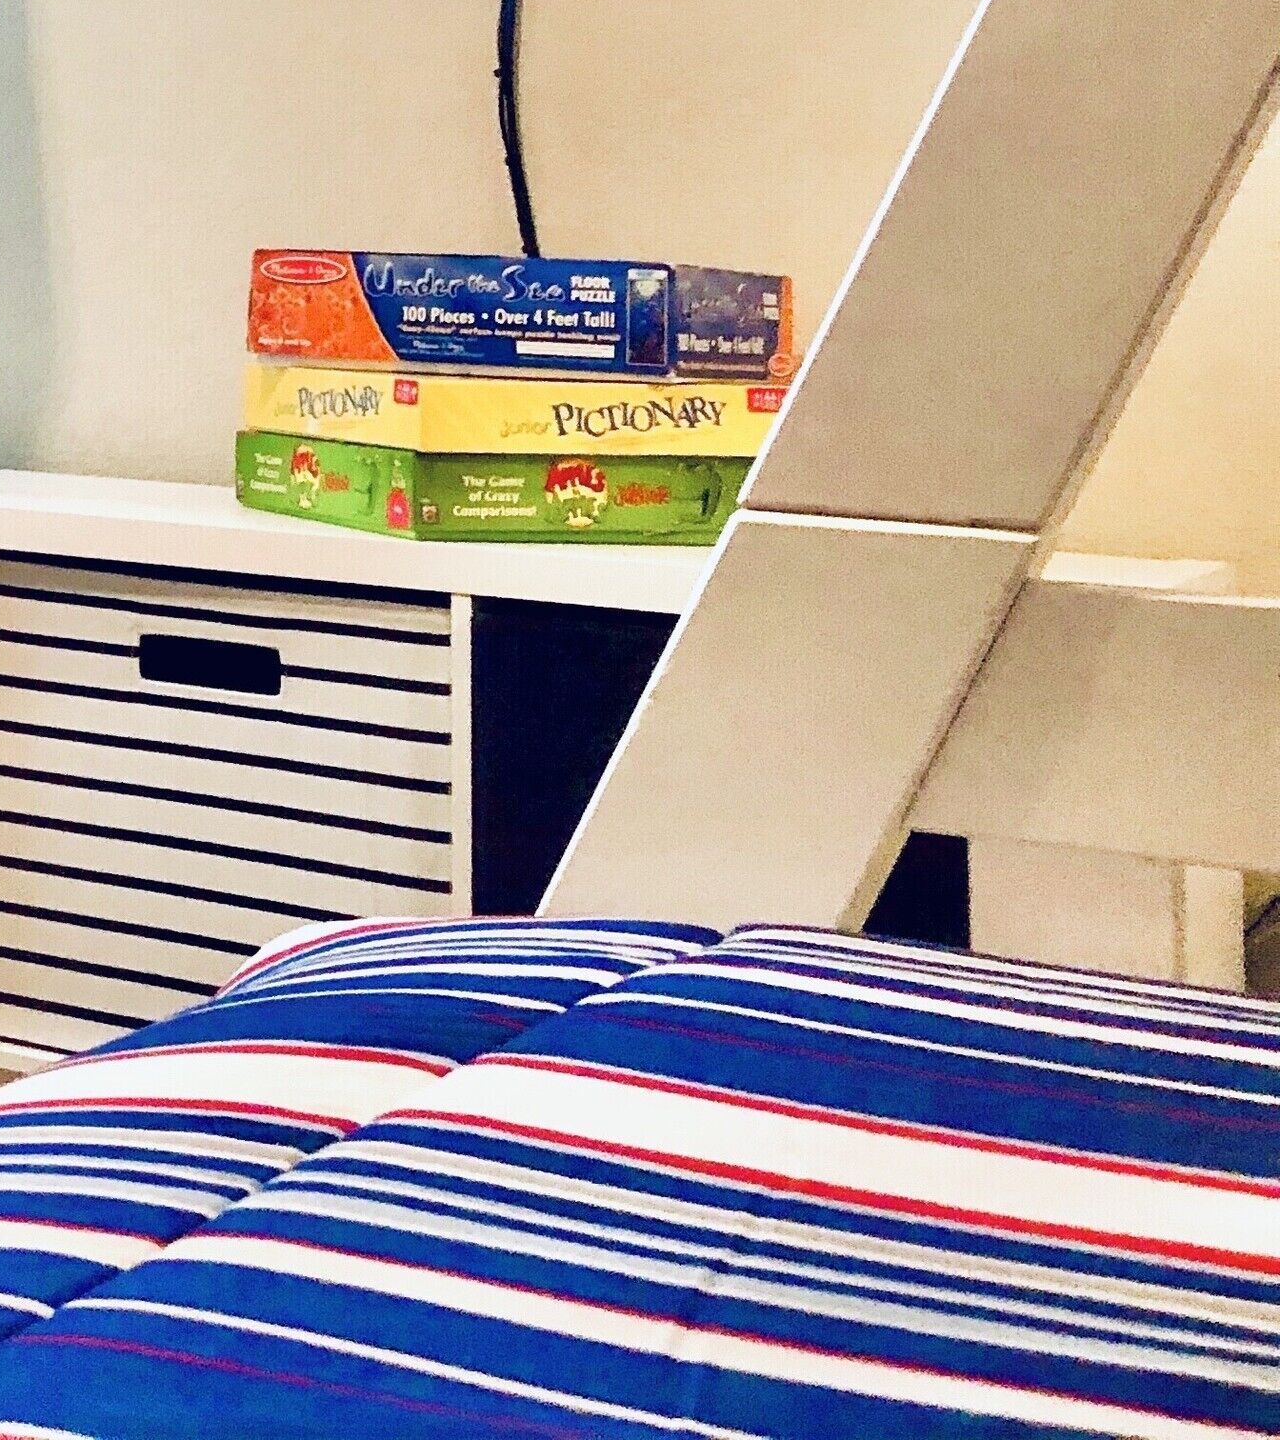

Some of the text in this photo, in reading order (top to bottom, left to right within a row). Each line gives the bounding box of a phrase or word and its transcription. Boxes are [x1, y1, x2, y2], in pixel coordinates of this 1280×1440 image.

[364, 262, 464, 298] Under
[467, 274, 500, 293] the
[502, 265, 565, 302] Sea
[571, 275, 610, 289] FLOOR
[571, 289, 616, 303] PUZZLE
[402, 306, 615, 328] 100 Pieces Over 4 Feet Tall!
[298, 385, 383, 419] PICTIONARY
[552, 396, 727, 437] PICTIONARY
[462, 475, 525, 489] The Game
[468, 489, 520, 504] of Crazy
[453, 505, 537, 520] Comparisons!
